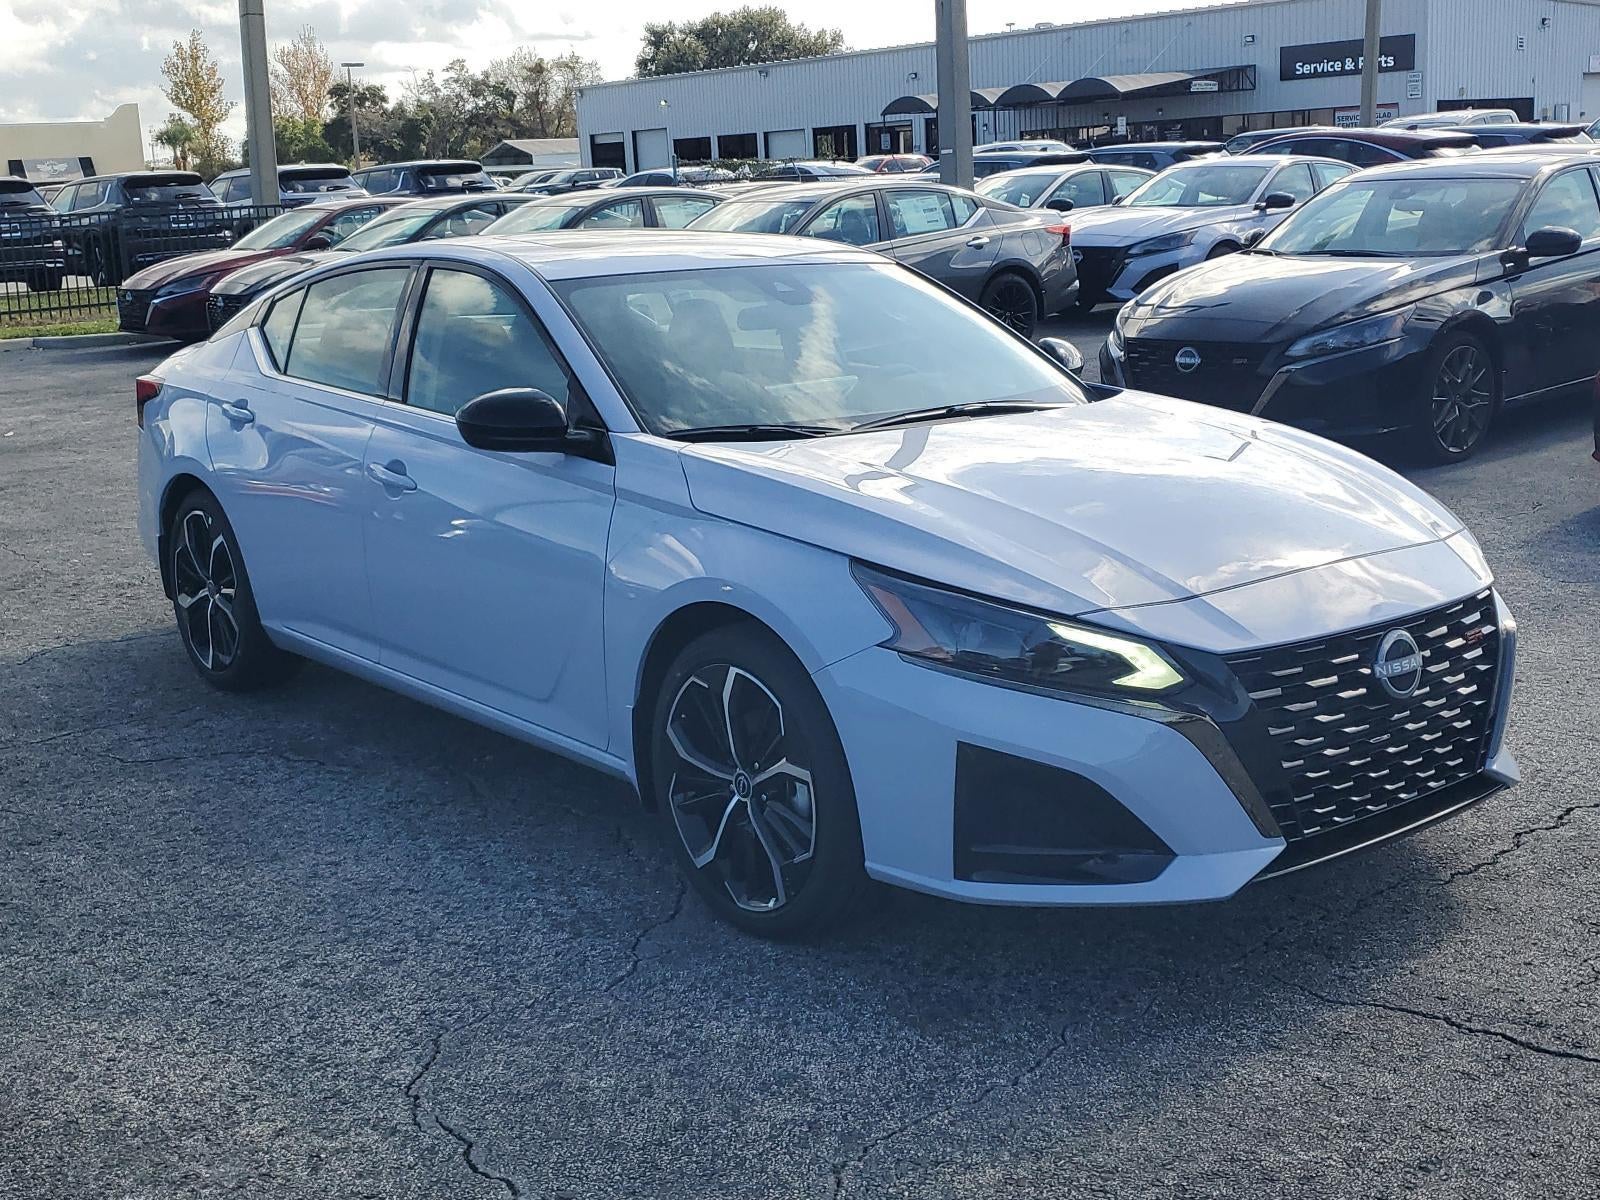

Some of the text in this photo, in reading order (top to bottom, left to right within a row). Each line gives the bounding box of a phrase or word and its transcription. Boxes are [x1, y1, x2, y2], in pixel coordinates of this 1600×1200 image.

[1295, 54, 1395, 75] Service & Pts
[1336, 114, 1360, 123] SERVIC
